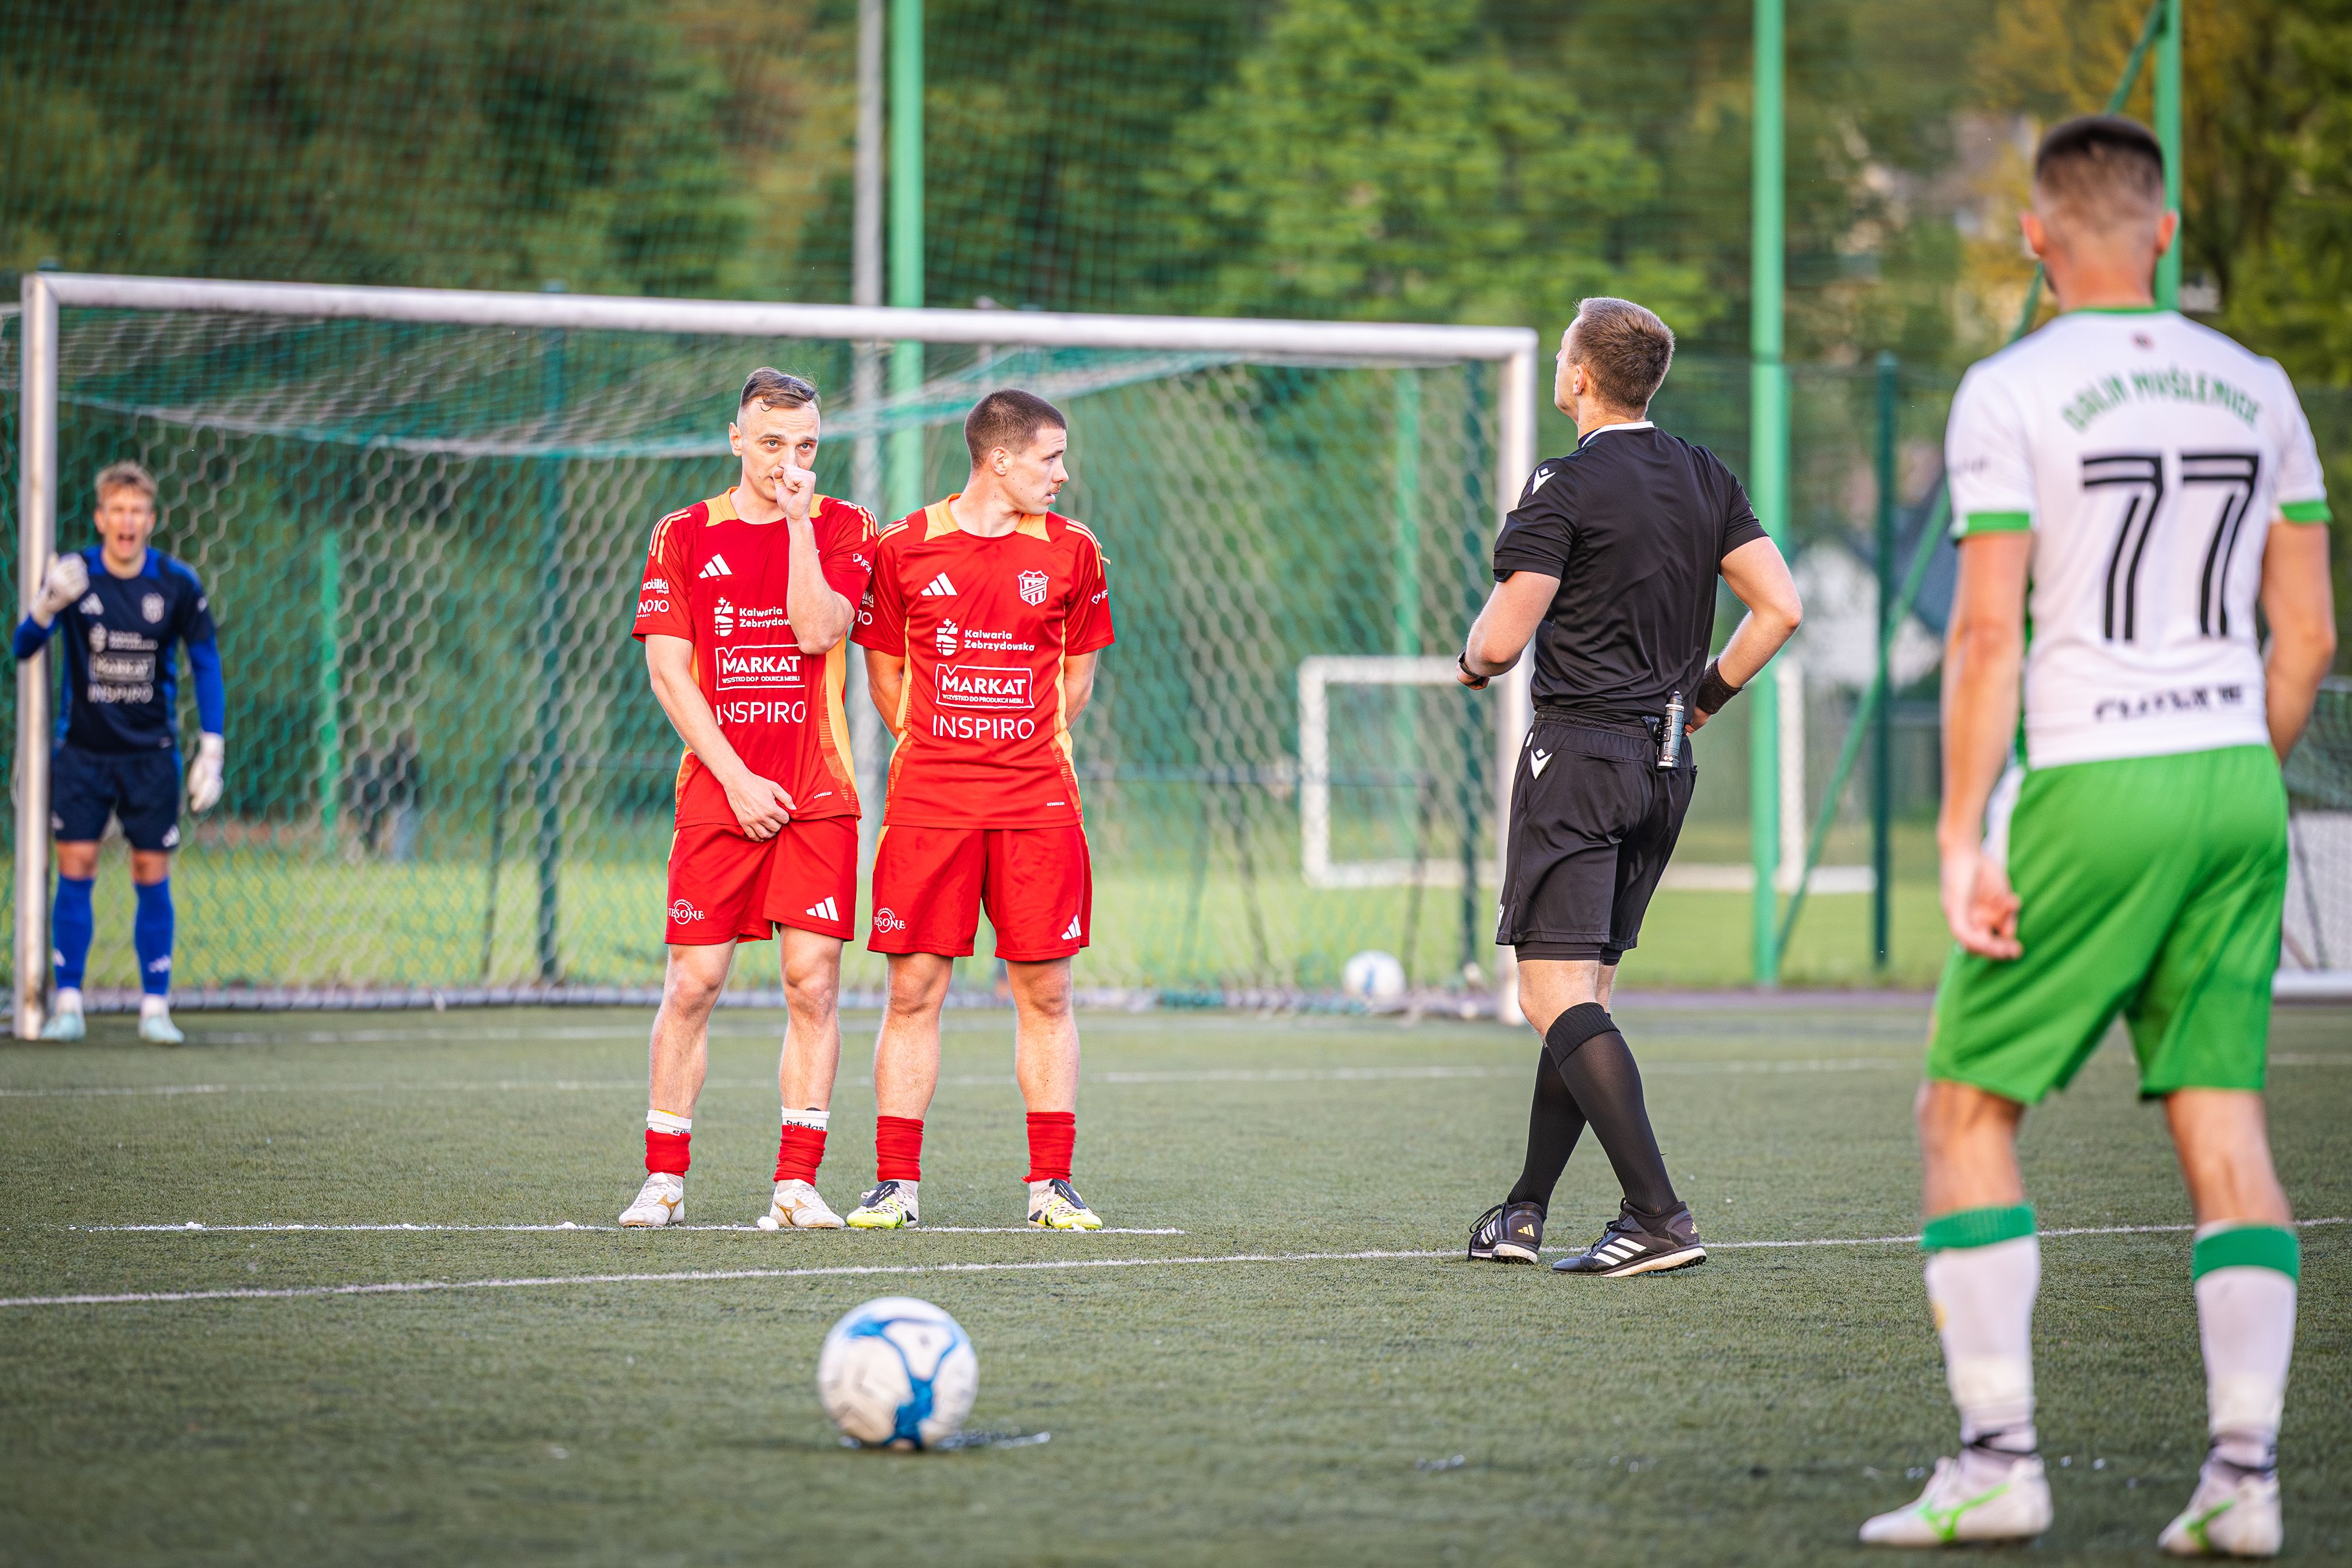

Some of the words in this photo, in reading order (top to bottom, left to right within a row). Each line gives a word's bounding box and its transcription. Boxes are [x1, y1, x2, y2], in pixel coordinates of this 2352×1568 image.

[2082, 454, 2259, 641] 77
[739, 606, 783, 617] Kalwaria
[857, 609, 873, 625] 10
[739, 617, 791, 628] Zebrzydow
[965, 629, 1012, 640] Kalwaria
[964, 640, 1035, 652] Zebrzydowska
[722, 656, 801, 675] MARKAT
[942, 675, 1027, 695] MARKAT
[942, 693, 969, 701] WSZYSTKO
[715, 700, 807, 726] INSPIRO
[933, 714, 1035, 740] INSPIRO
[668, 907, 705, 921] TESONE
[873, 916, 906, 931] TESONE
